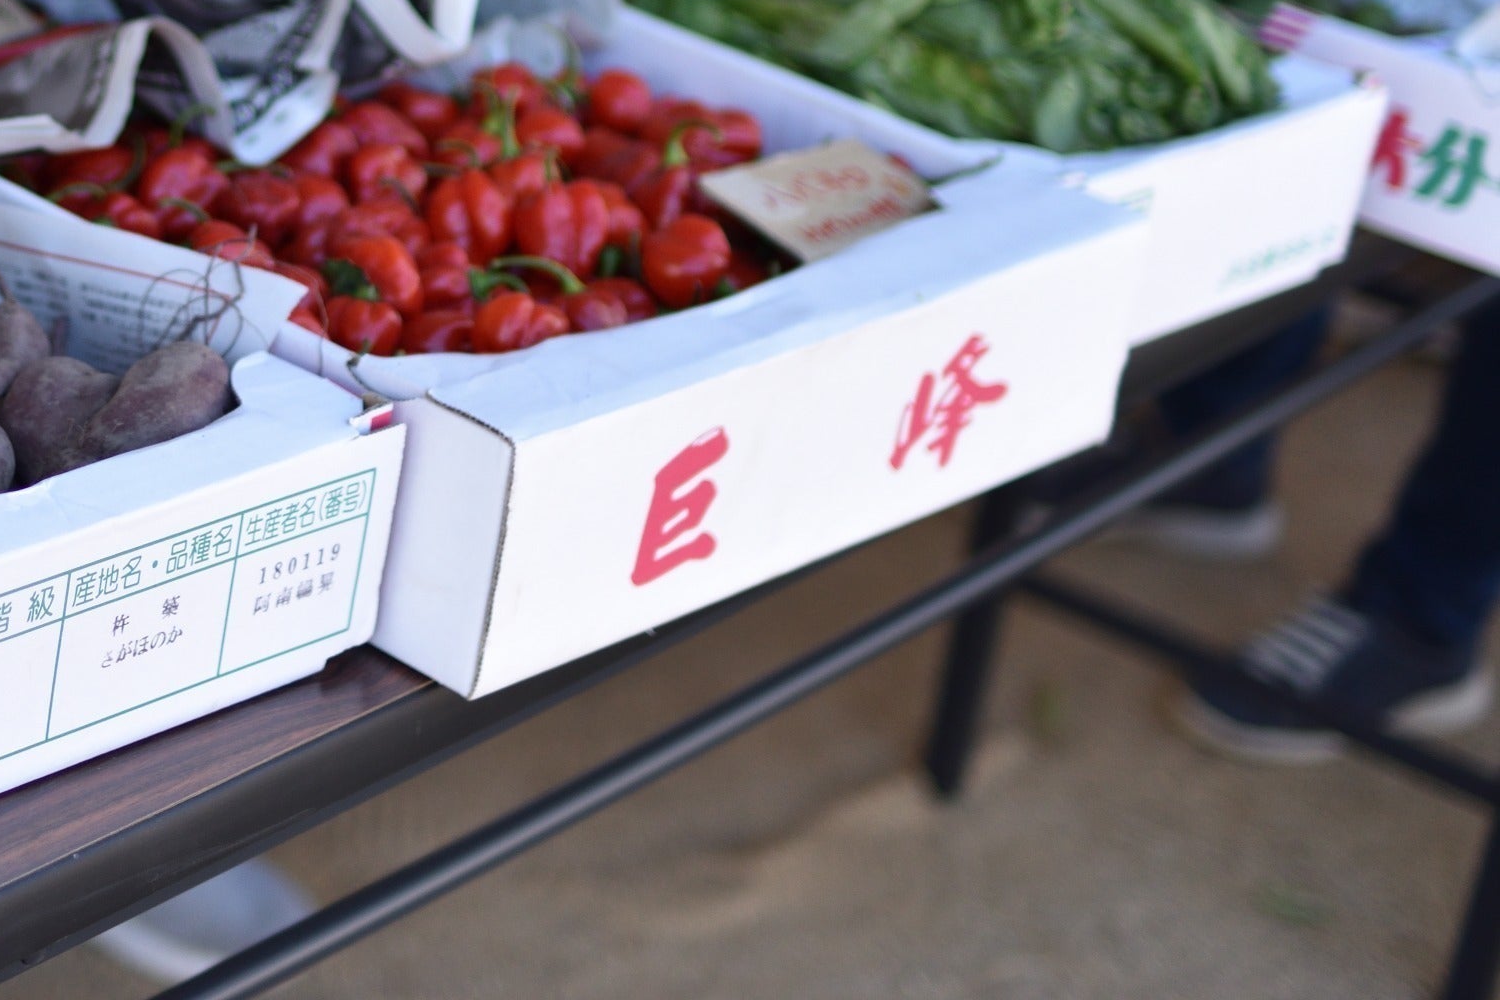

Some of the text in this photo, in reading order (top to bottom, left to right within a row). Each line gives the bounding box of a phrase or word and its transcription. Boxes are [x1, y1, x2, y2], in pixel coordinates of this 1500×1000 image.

[71, 523, 234, 608] 産地名・品種名
[100, 625, 184, 669] さがほのか
